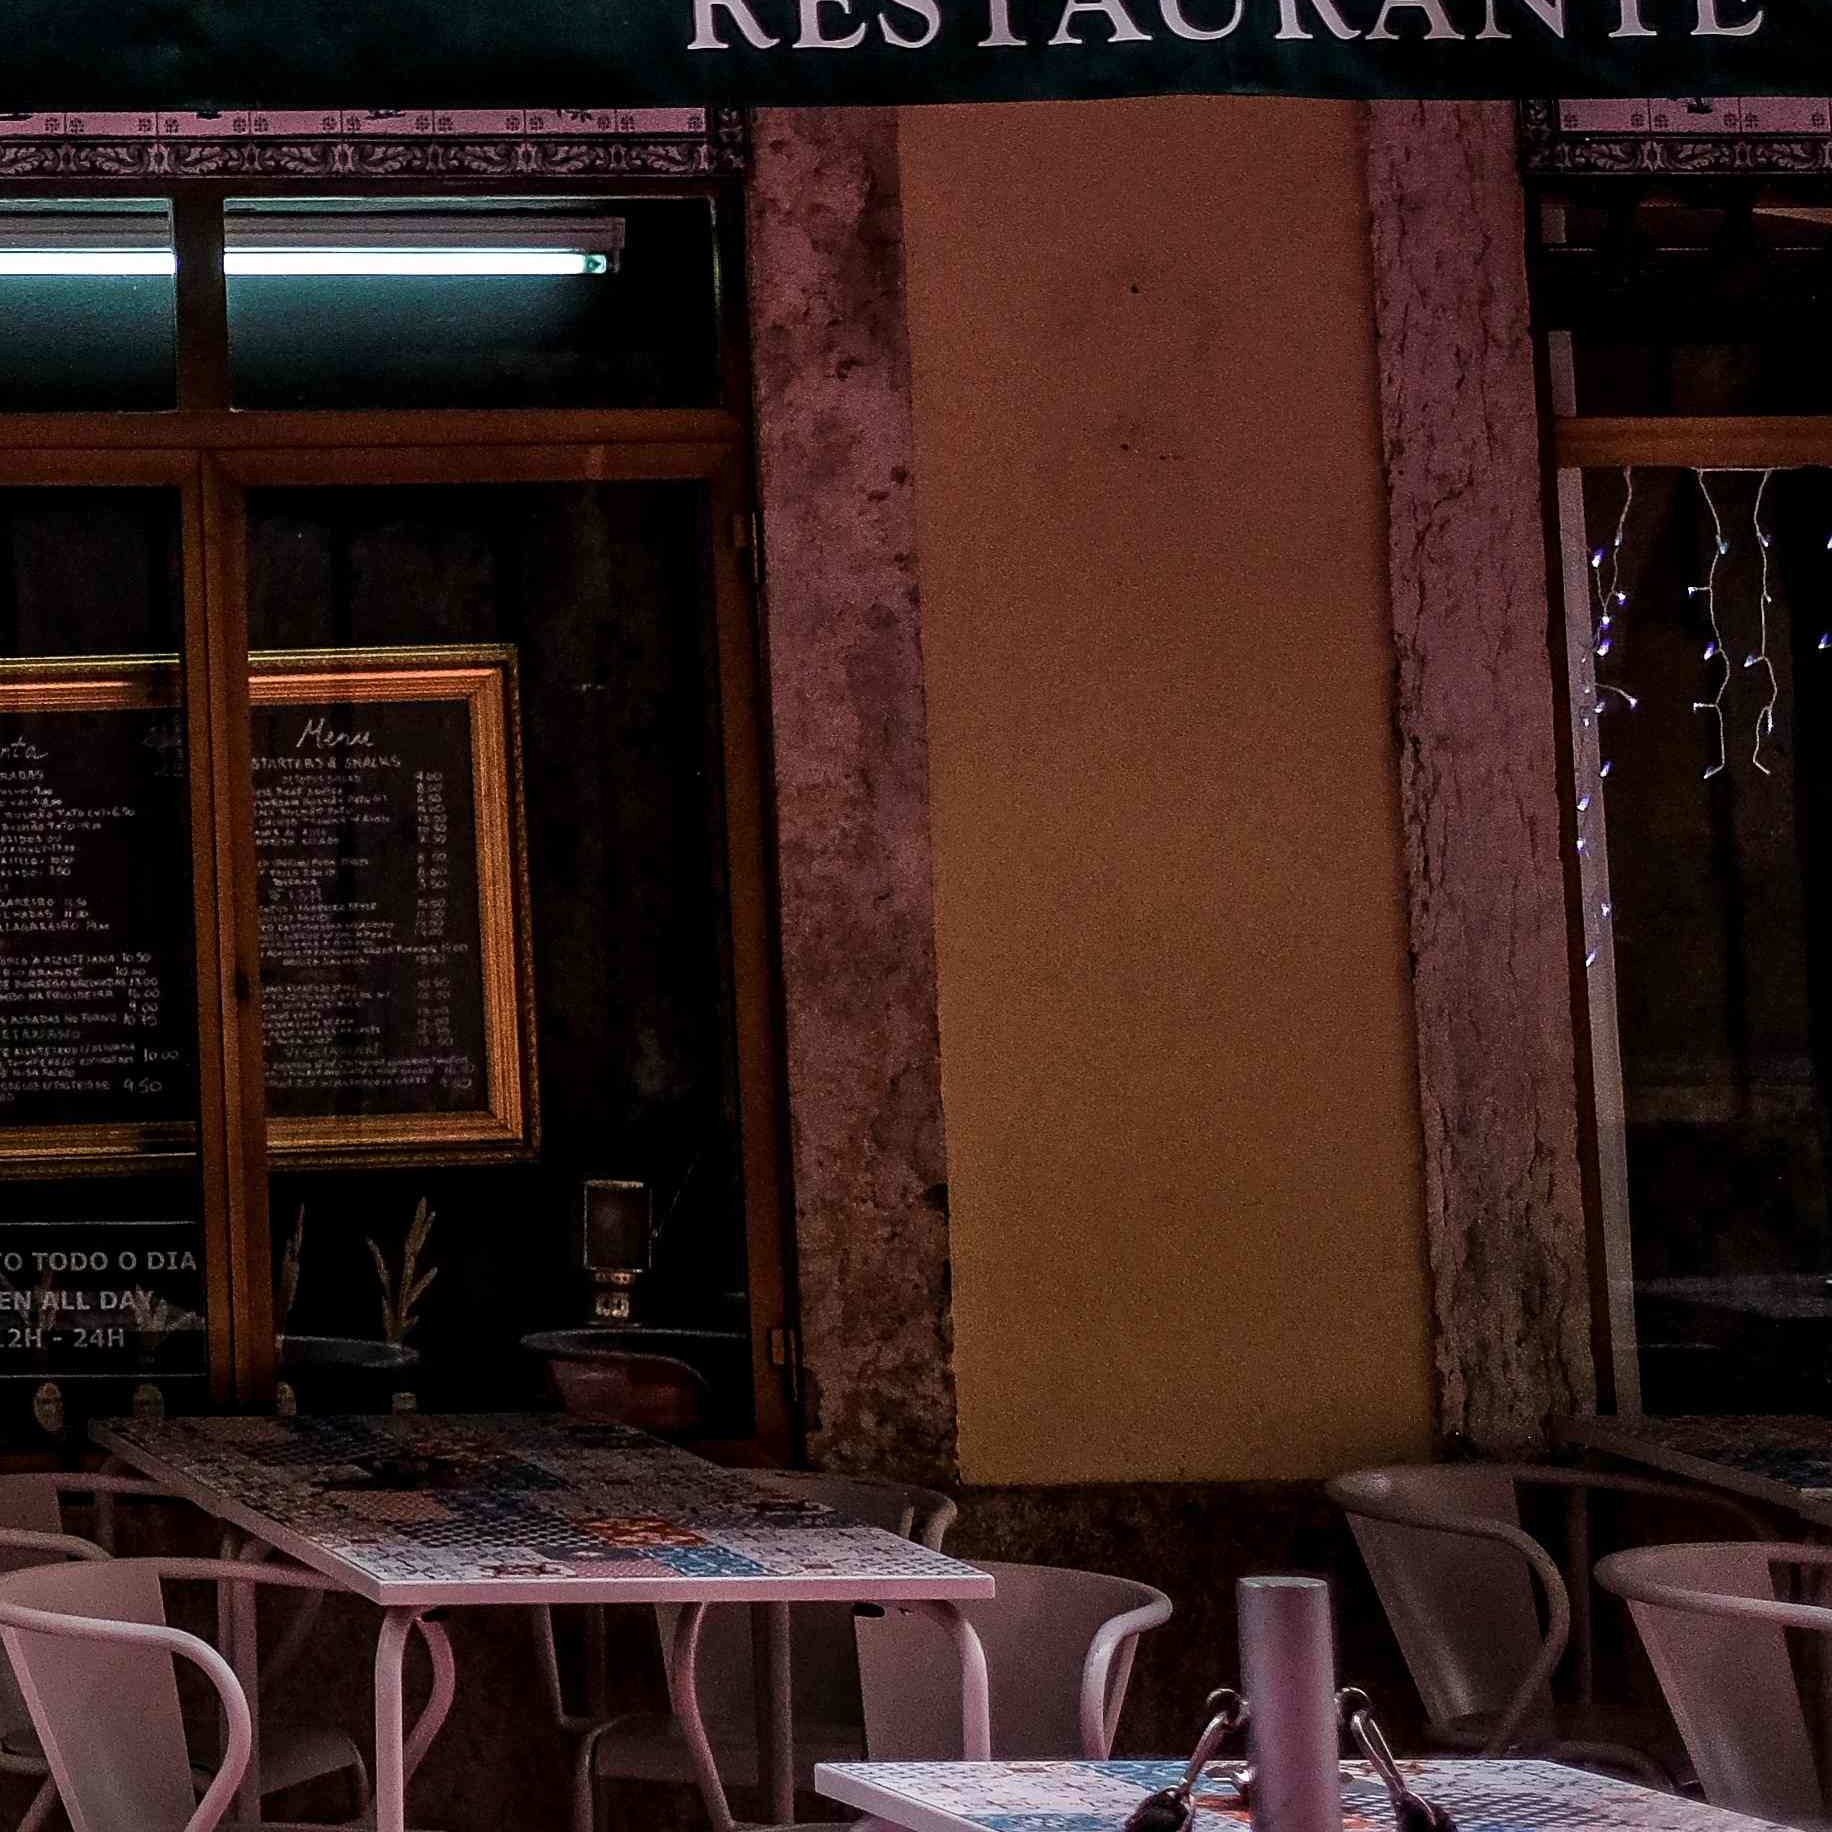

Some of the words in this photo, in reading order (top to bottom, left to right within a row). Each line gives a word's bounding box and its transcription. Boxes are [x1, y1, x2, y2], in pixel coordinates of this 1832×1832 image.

[296, 718, 374, 749] Menu
[31, 1251, 108, 1271] TODO
[119, 1251, 137, 1271] O
[147, 1251, 197, 1271] DIA
[41, 1290, 90, 1311] ALL
[100, 1290, 154, 1312] DAY
[73, 1327, 125, 1348] 24H
